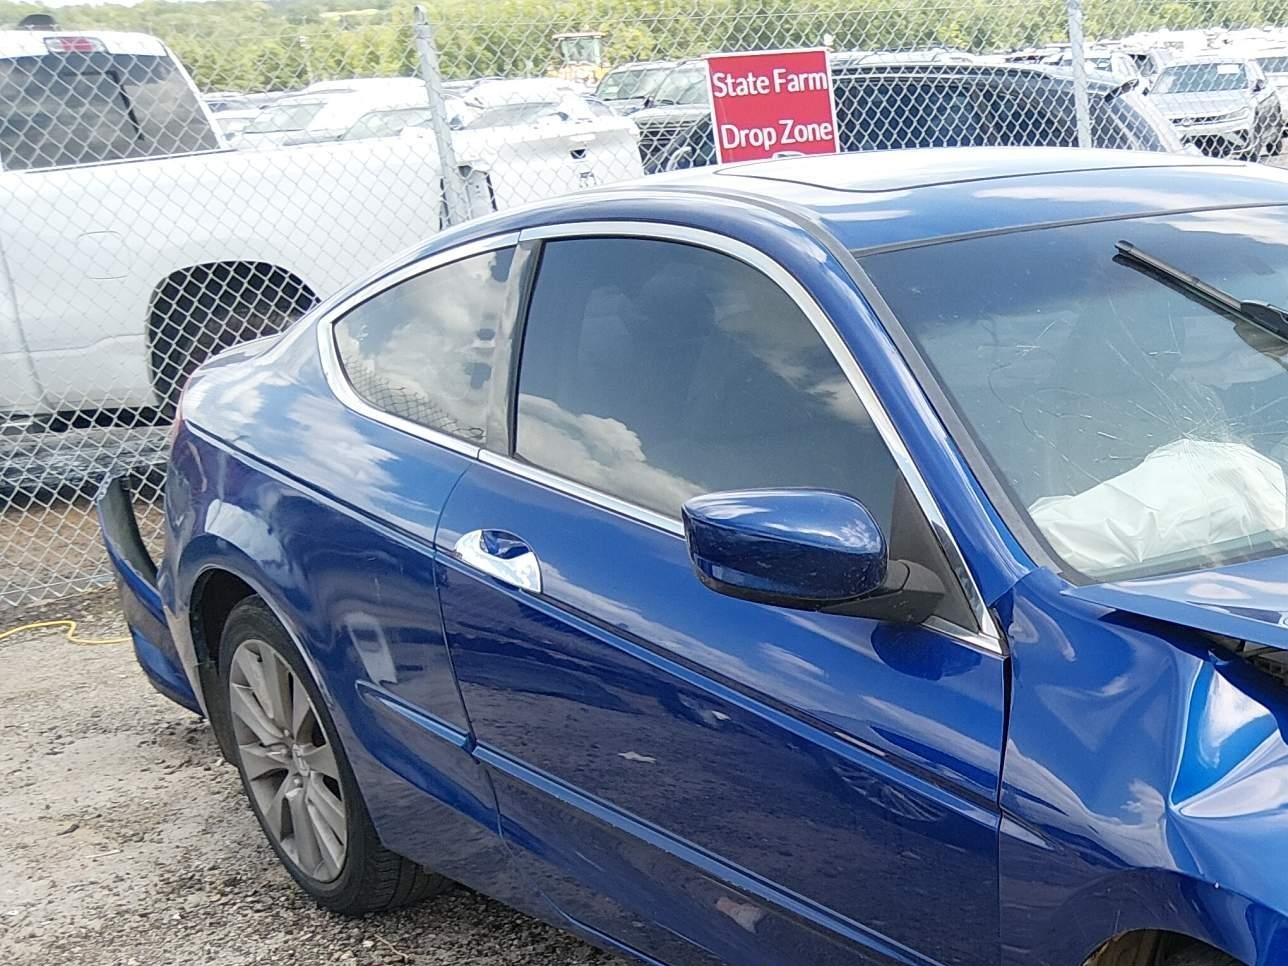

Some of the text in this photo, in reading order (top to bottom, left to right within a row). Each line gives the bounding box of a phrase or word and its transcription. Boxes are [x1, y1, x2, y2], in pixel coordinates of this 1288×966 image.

[712, 68, 829, 98] State Farm
[720, 119, 833, 151] Drop Zone
